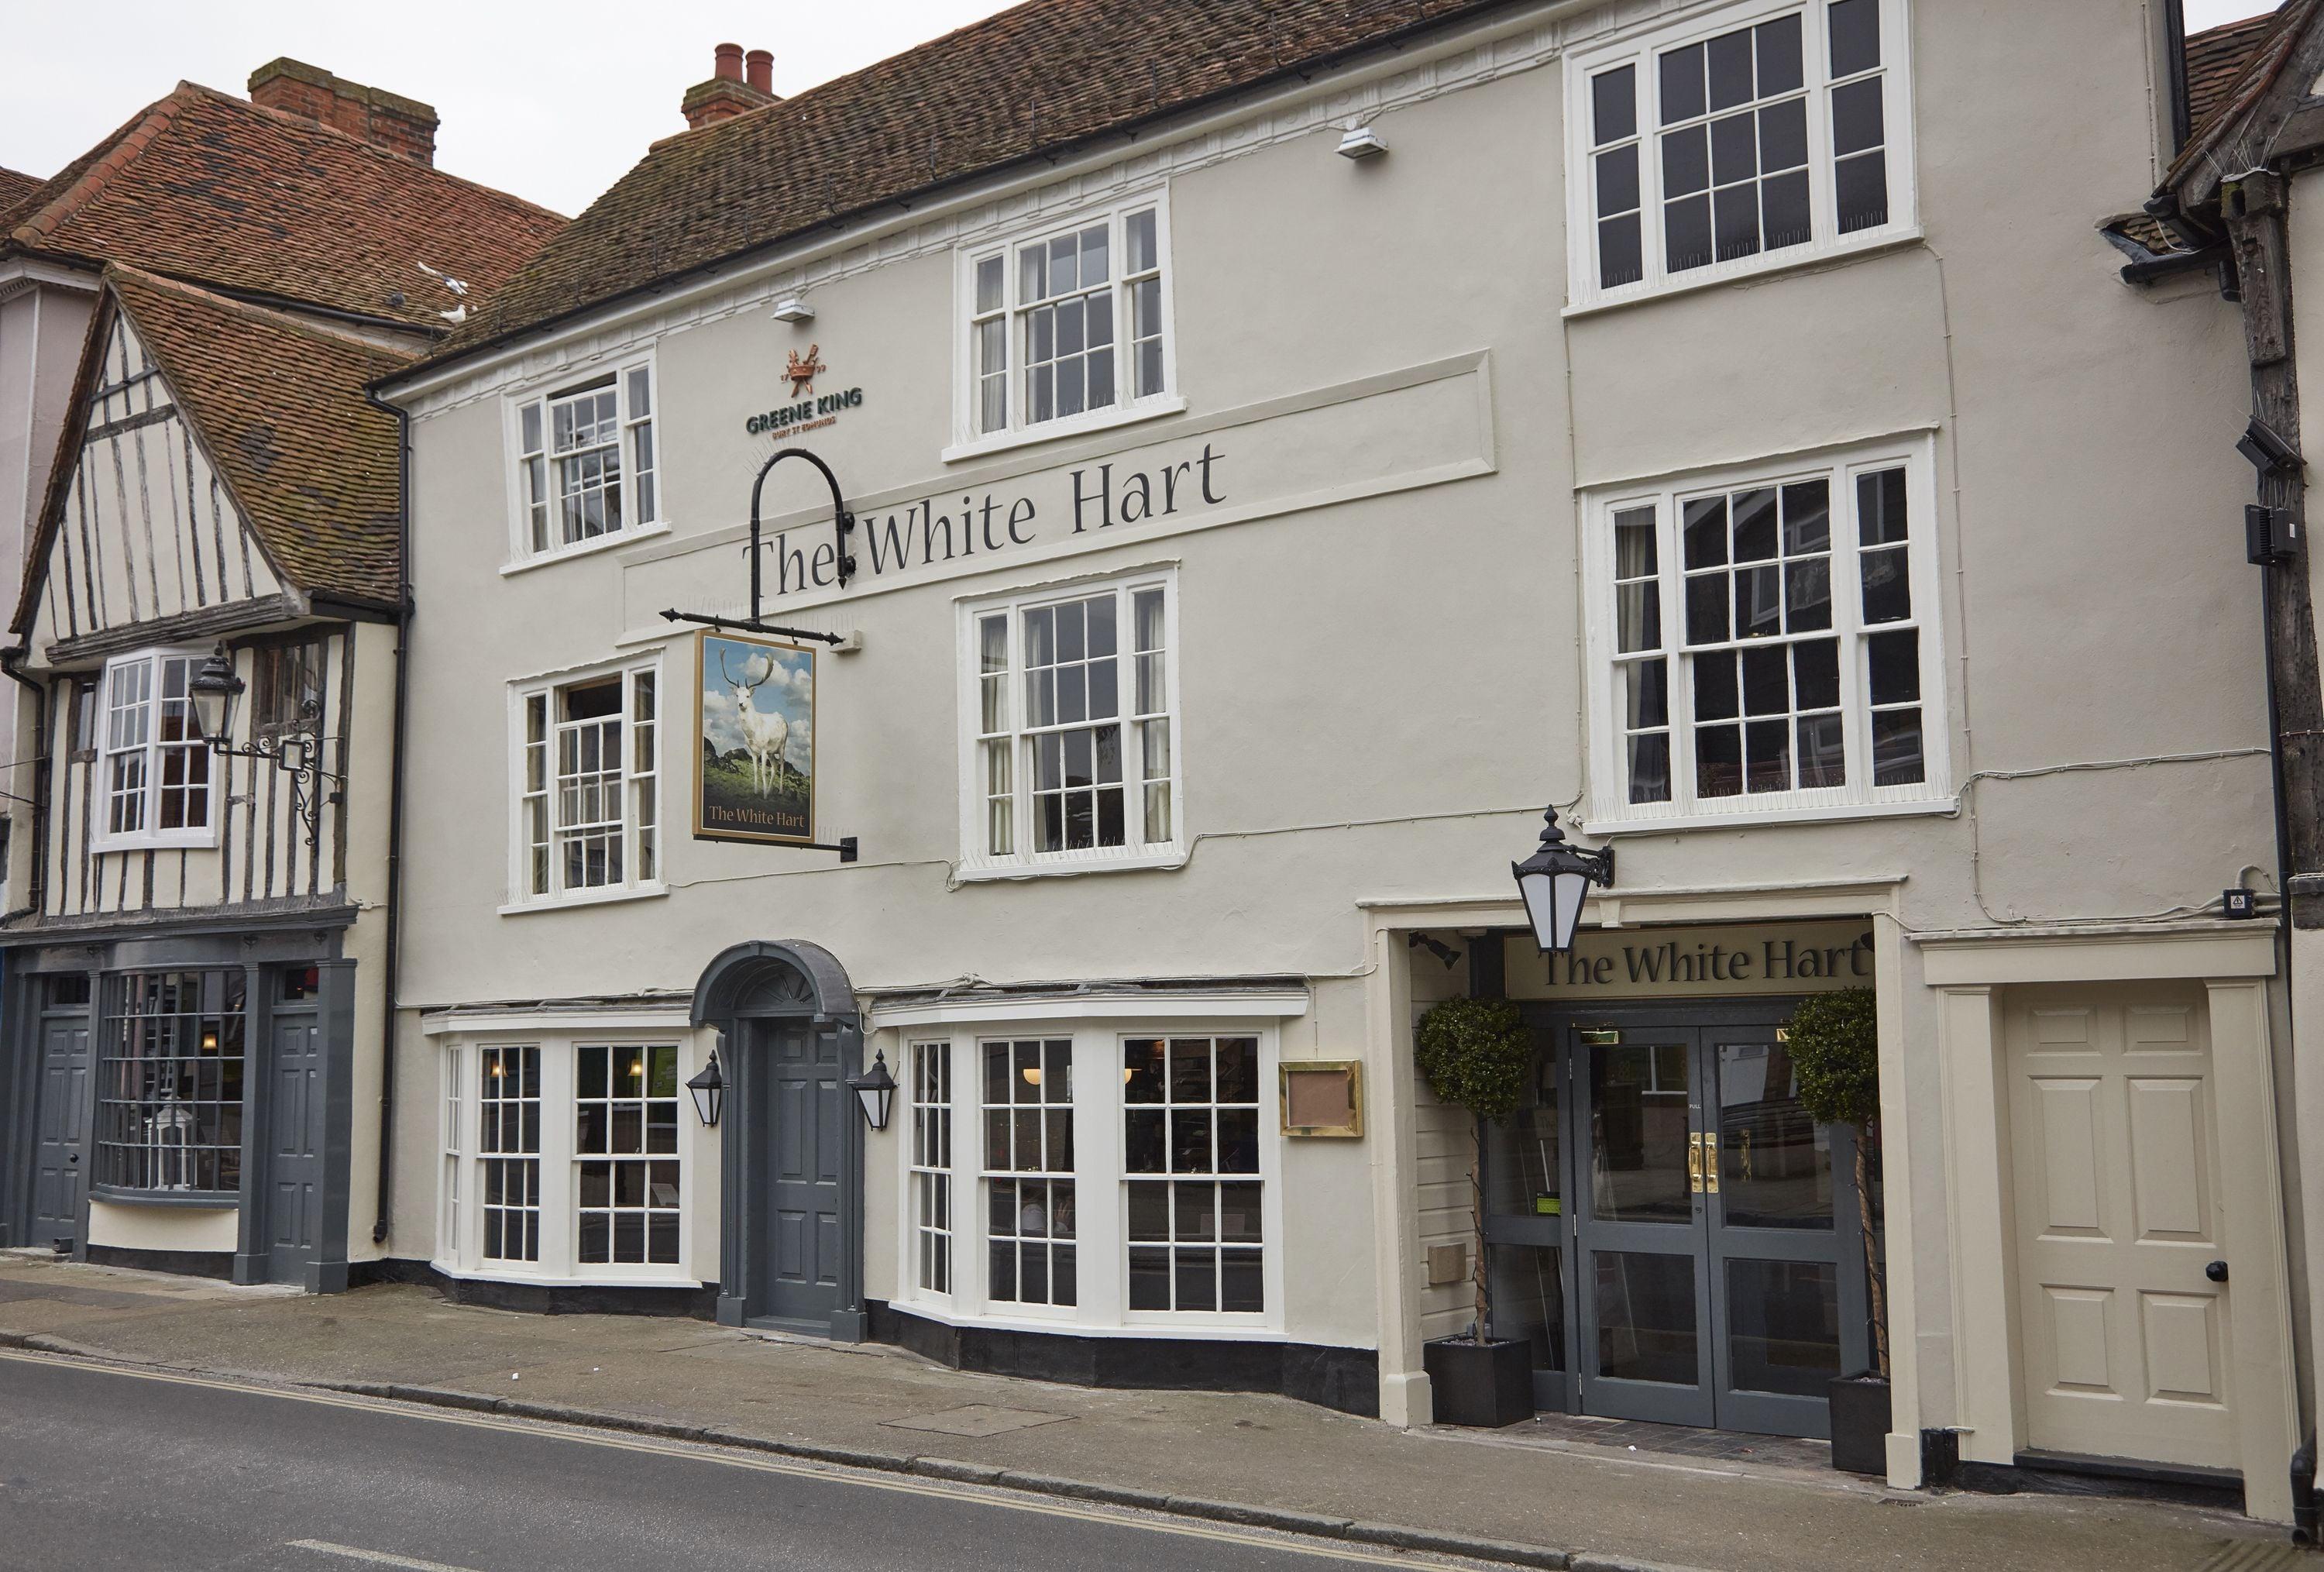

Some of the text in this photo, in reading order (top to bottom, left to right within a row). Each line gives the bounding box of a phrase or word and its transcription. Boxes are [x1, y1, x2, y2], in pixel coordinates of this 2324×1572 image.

[746, 387, 862, 434] GREENE KING
[863, 494, 1037, 576] White
[1069, 442, 1227, 535] Hart
[709, 805, 806, 827] The White Hart
[1623, 941, 1750, 983] White
[1762, 939, 1868, 979] Hart
